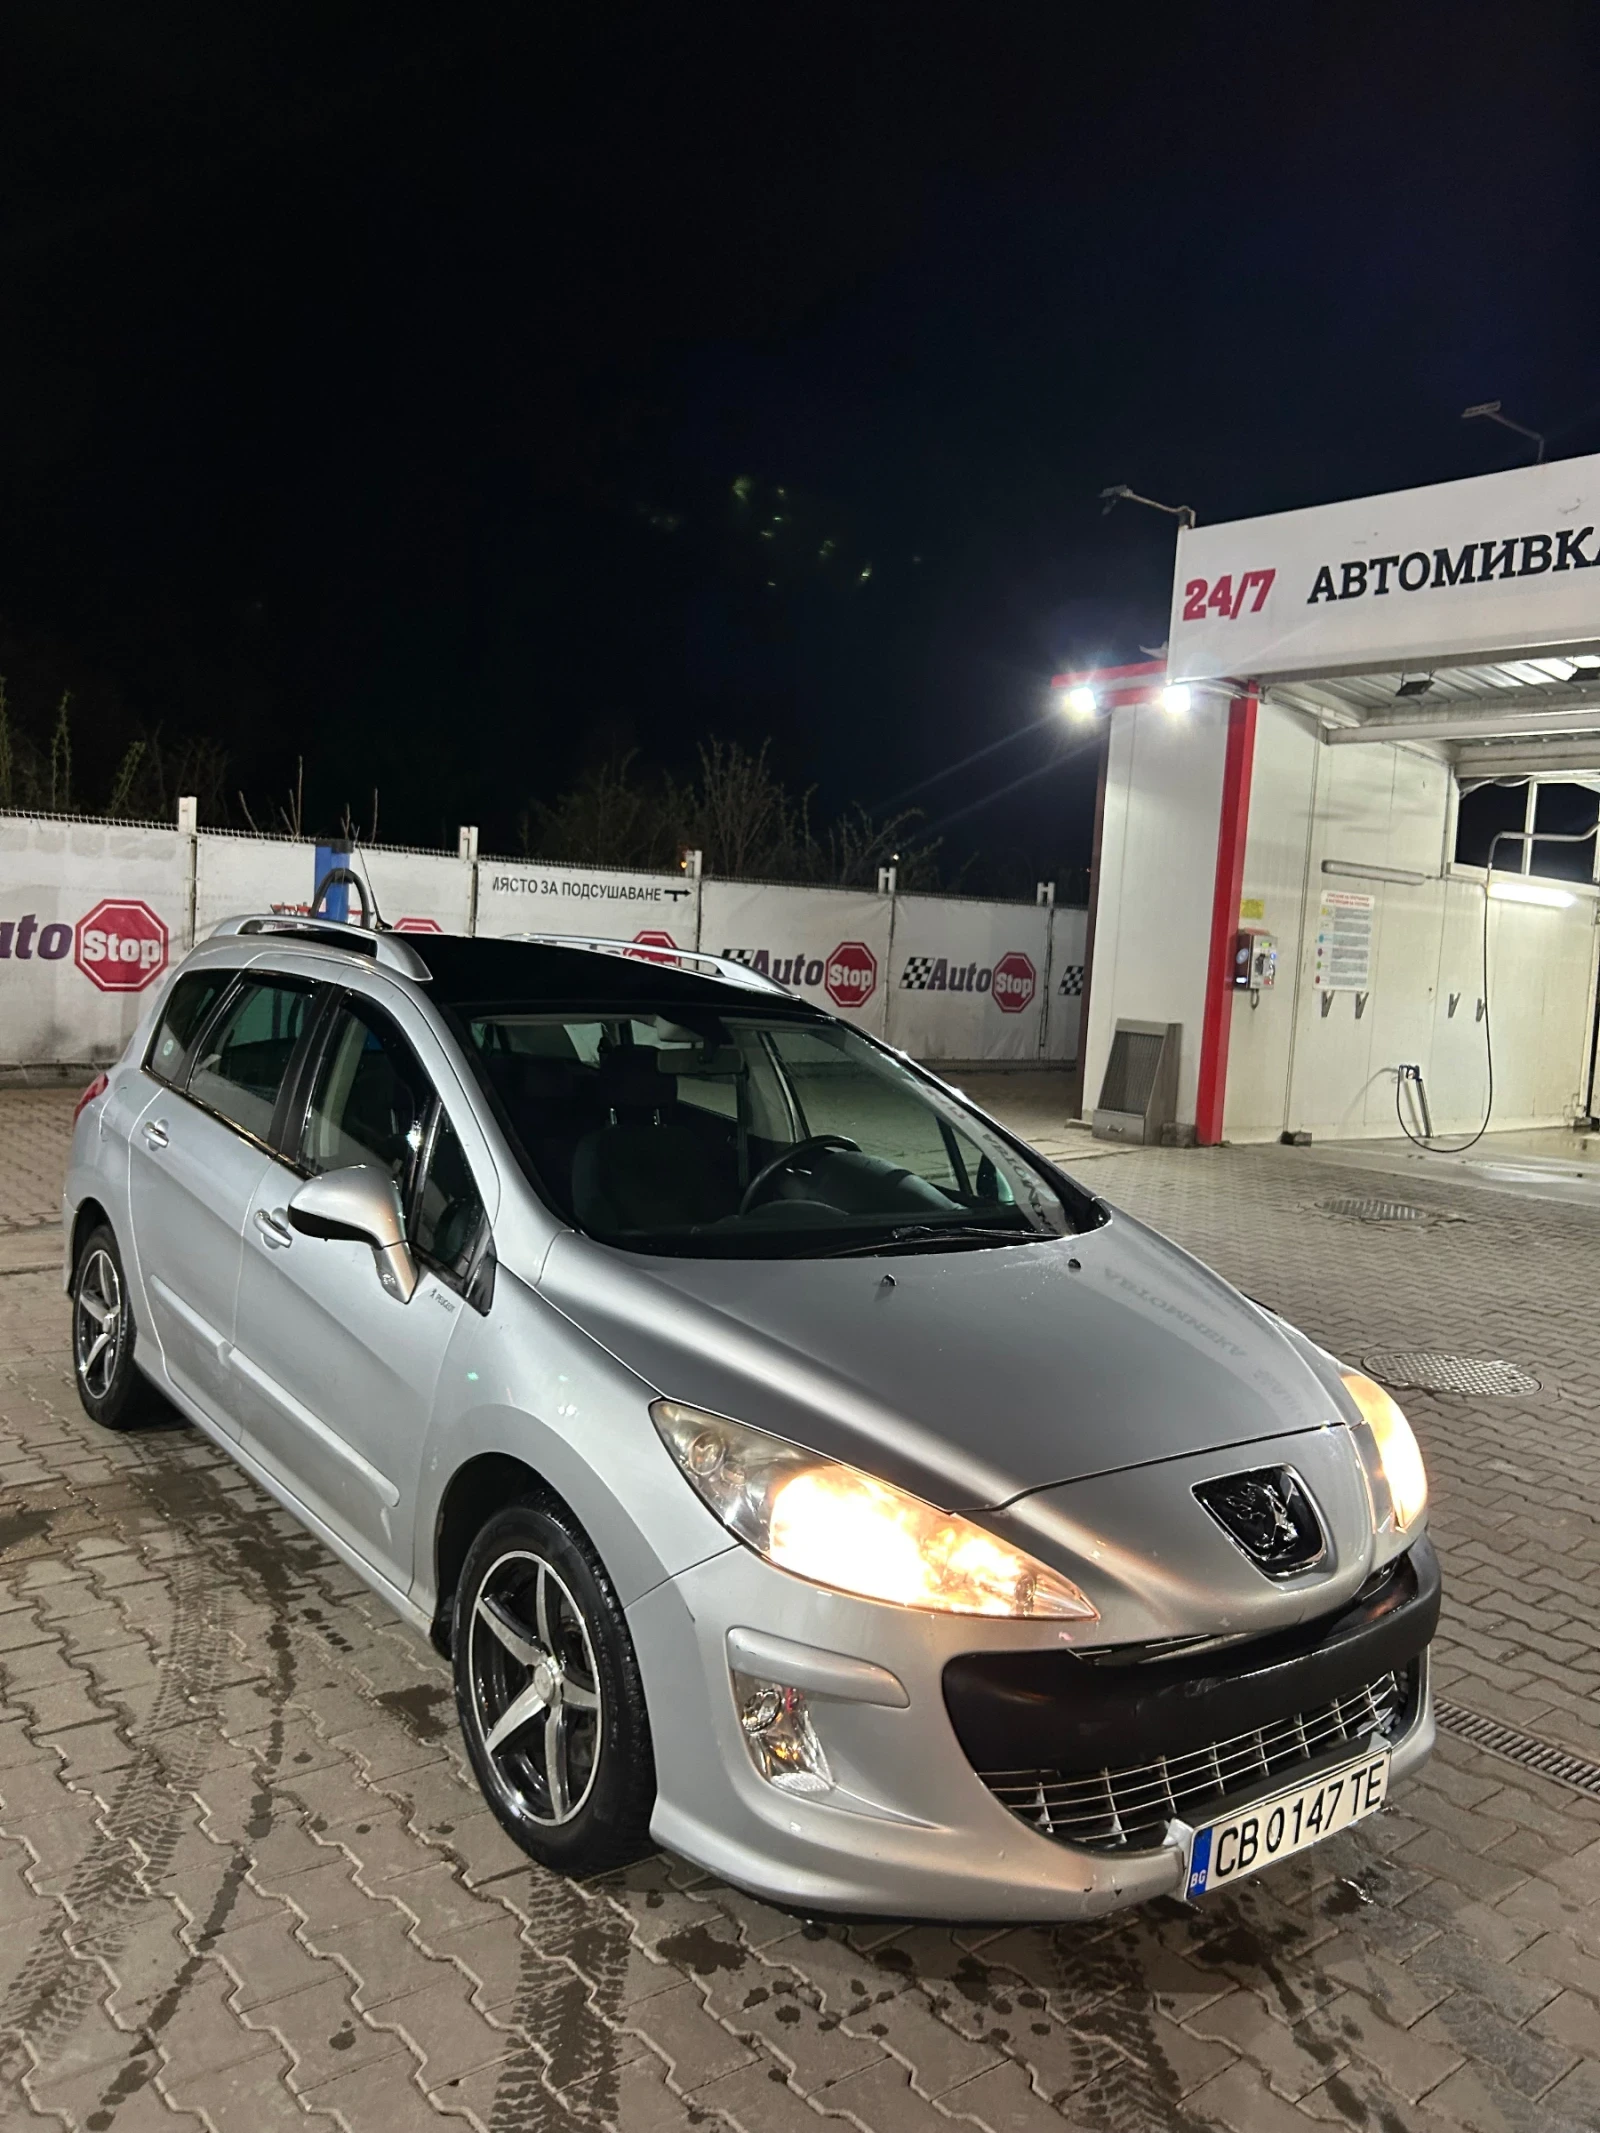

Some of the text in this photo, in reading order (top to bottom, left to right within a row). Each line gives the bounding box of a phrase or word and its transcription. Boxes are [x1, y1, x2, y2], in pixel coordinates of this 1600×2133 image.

[1183, 526, 1600, 621] 24/7 АВТОМИВК
[541, 880, 558, 895] ЗА
[563, 882, 662, 901] ПОДСУШАВАНЕ
[83, 930, 160, 969] Stop
[752, 950, 872, 991] Auto Stop
[927, 958, 1032, 998] Auto Stop
[1190, 1869, 1207, 1888] BG
